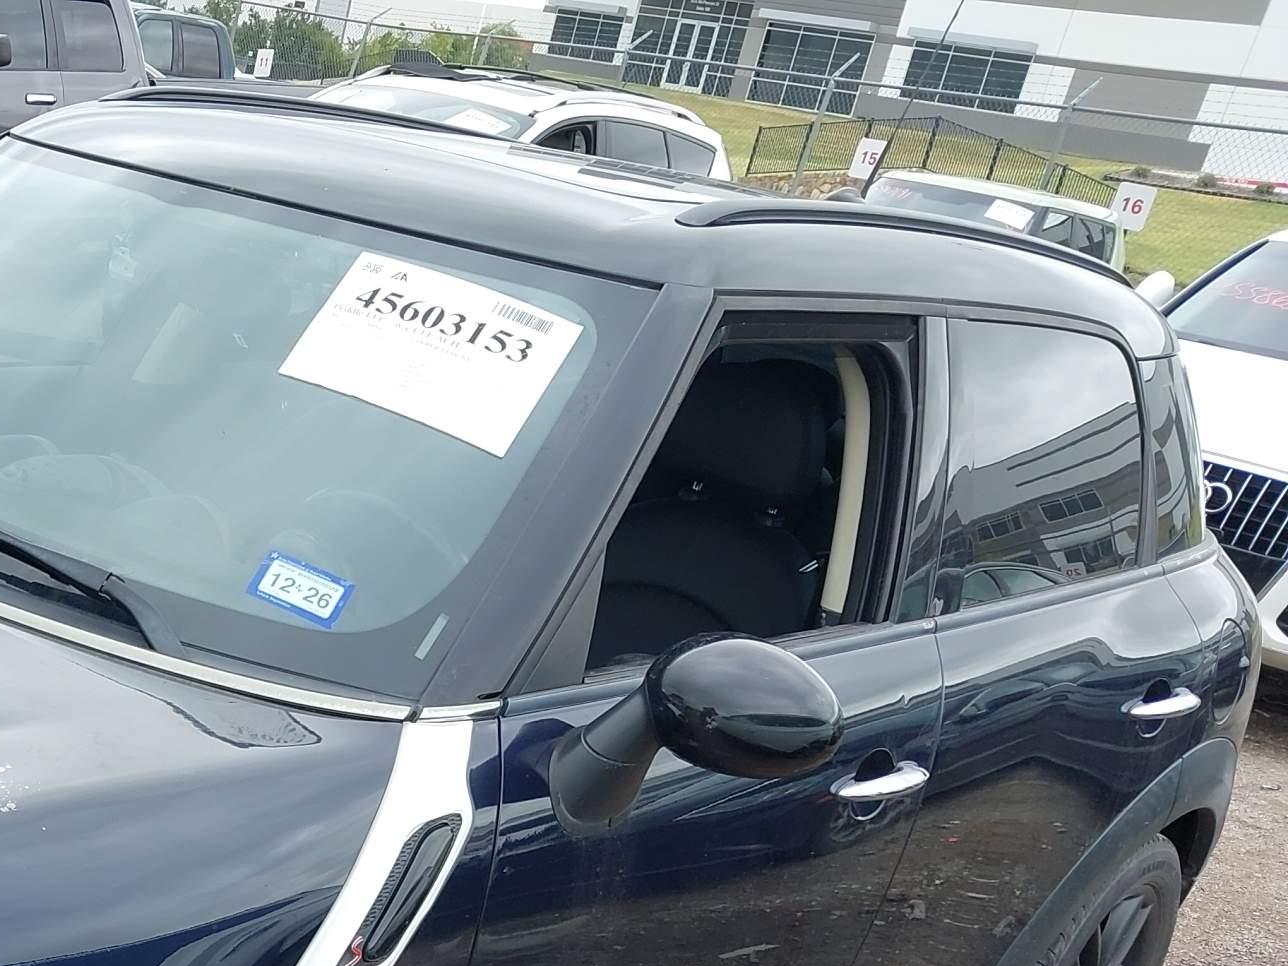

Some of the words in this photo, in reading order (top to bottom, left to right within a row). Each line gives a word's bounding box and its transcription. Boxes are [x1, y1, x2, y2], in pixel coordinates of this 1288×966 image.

[860, 150, 878, 166] 15
[1121, 196, 1144, 215] 16
[355, 287, 533, 362] 45603153
